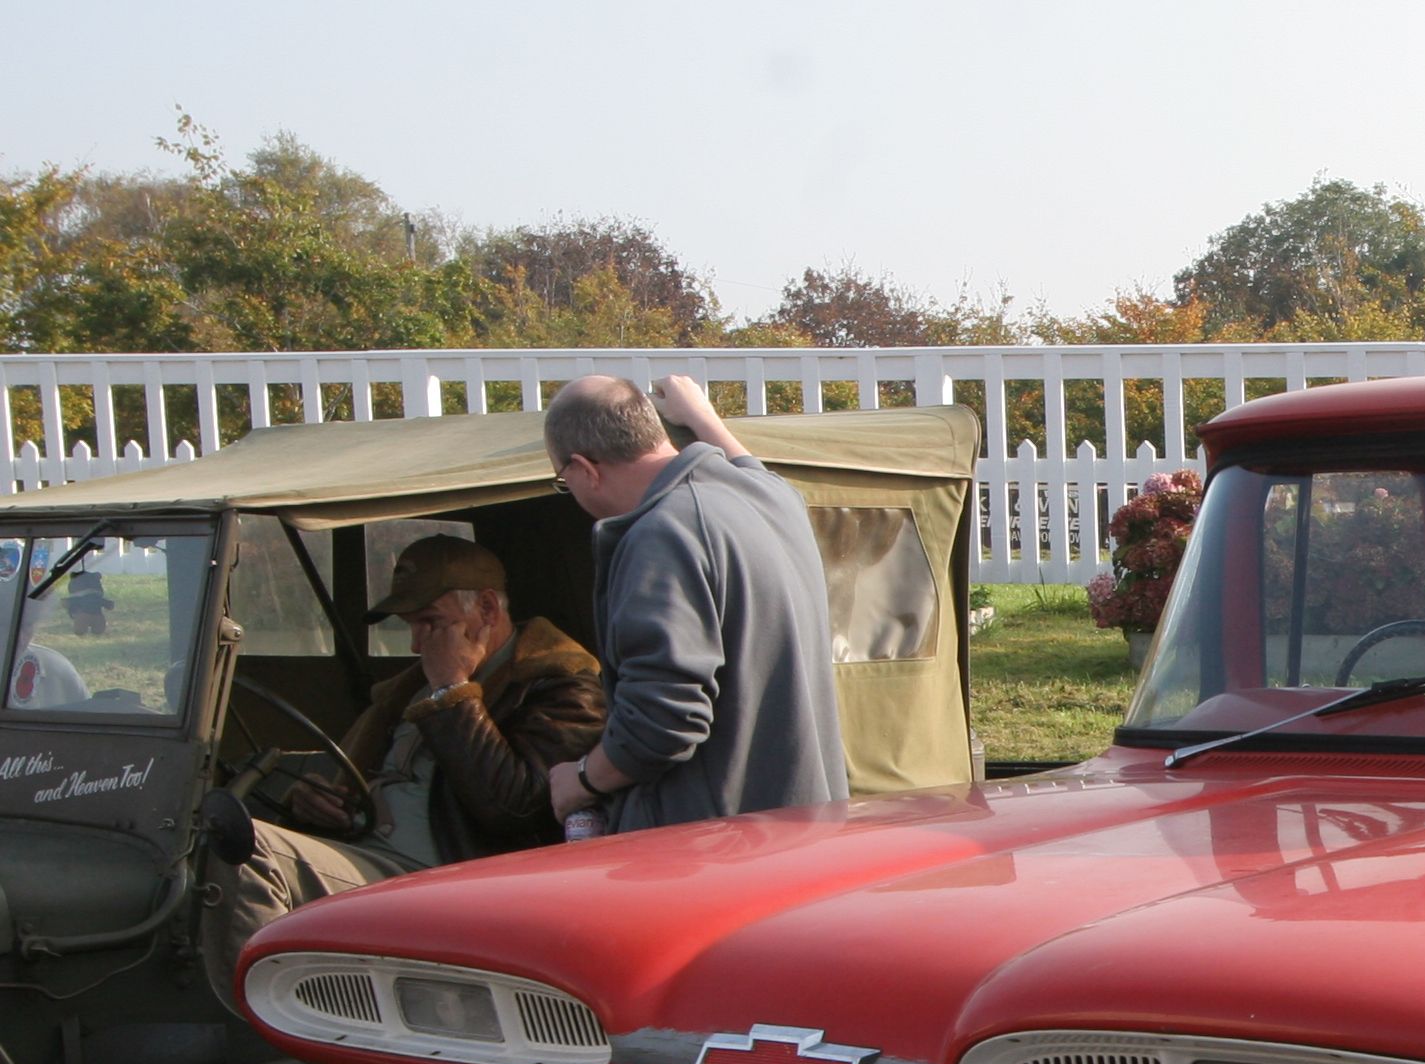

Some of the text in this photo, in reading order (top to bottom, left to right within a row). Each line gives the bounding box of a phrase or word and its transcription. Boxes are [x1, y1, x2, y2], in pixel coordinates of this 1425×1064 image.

[0, 756, 26, 780] All
[34, 757, 154, 803] and Heaven Too!
